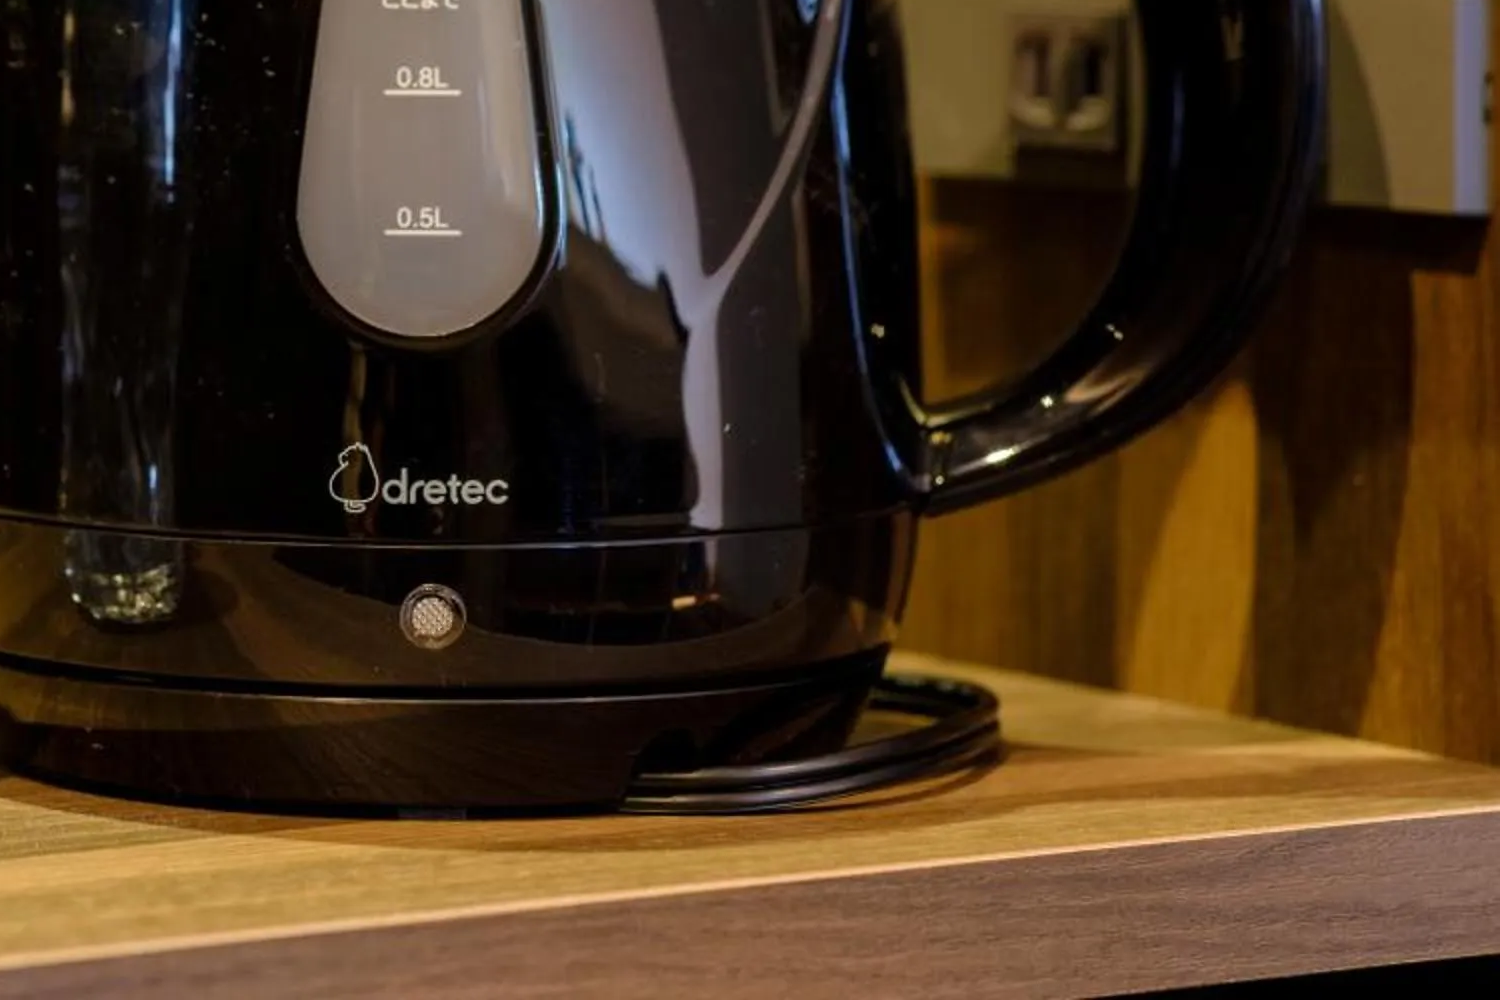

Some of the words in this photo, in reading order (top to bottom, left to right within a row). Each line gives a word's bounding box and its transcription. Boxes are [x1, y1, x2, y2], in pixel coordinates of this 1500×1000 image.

[396, 66, 449, 90] 0.8L
[396, 206, 449, 229] 0.5L
[381, 467, 509, 505] dretec
